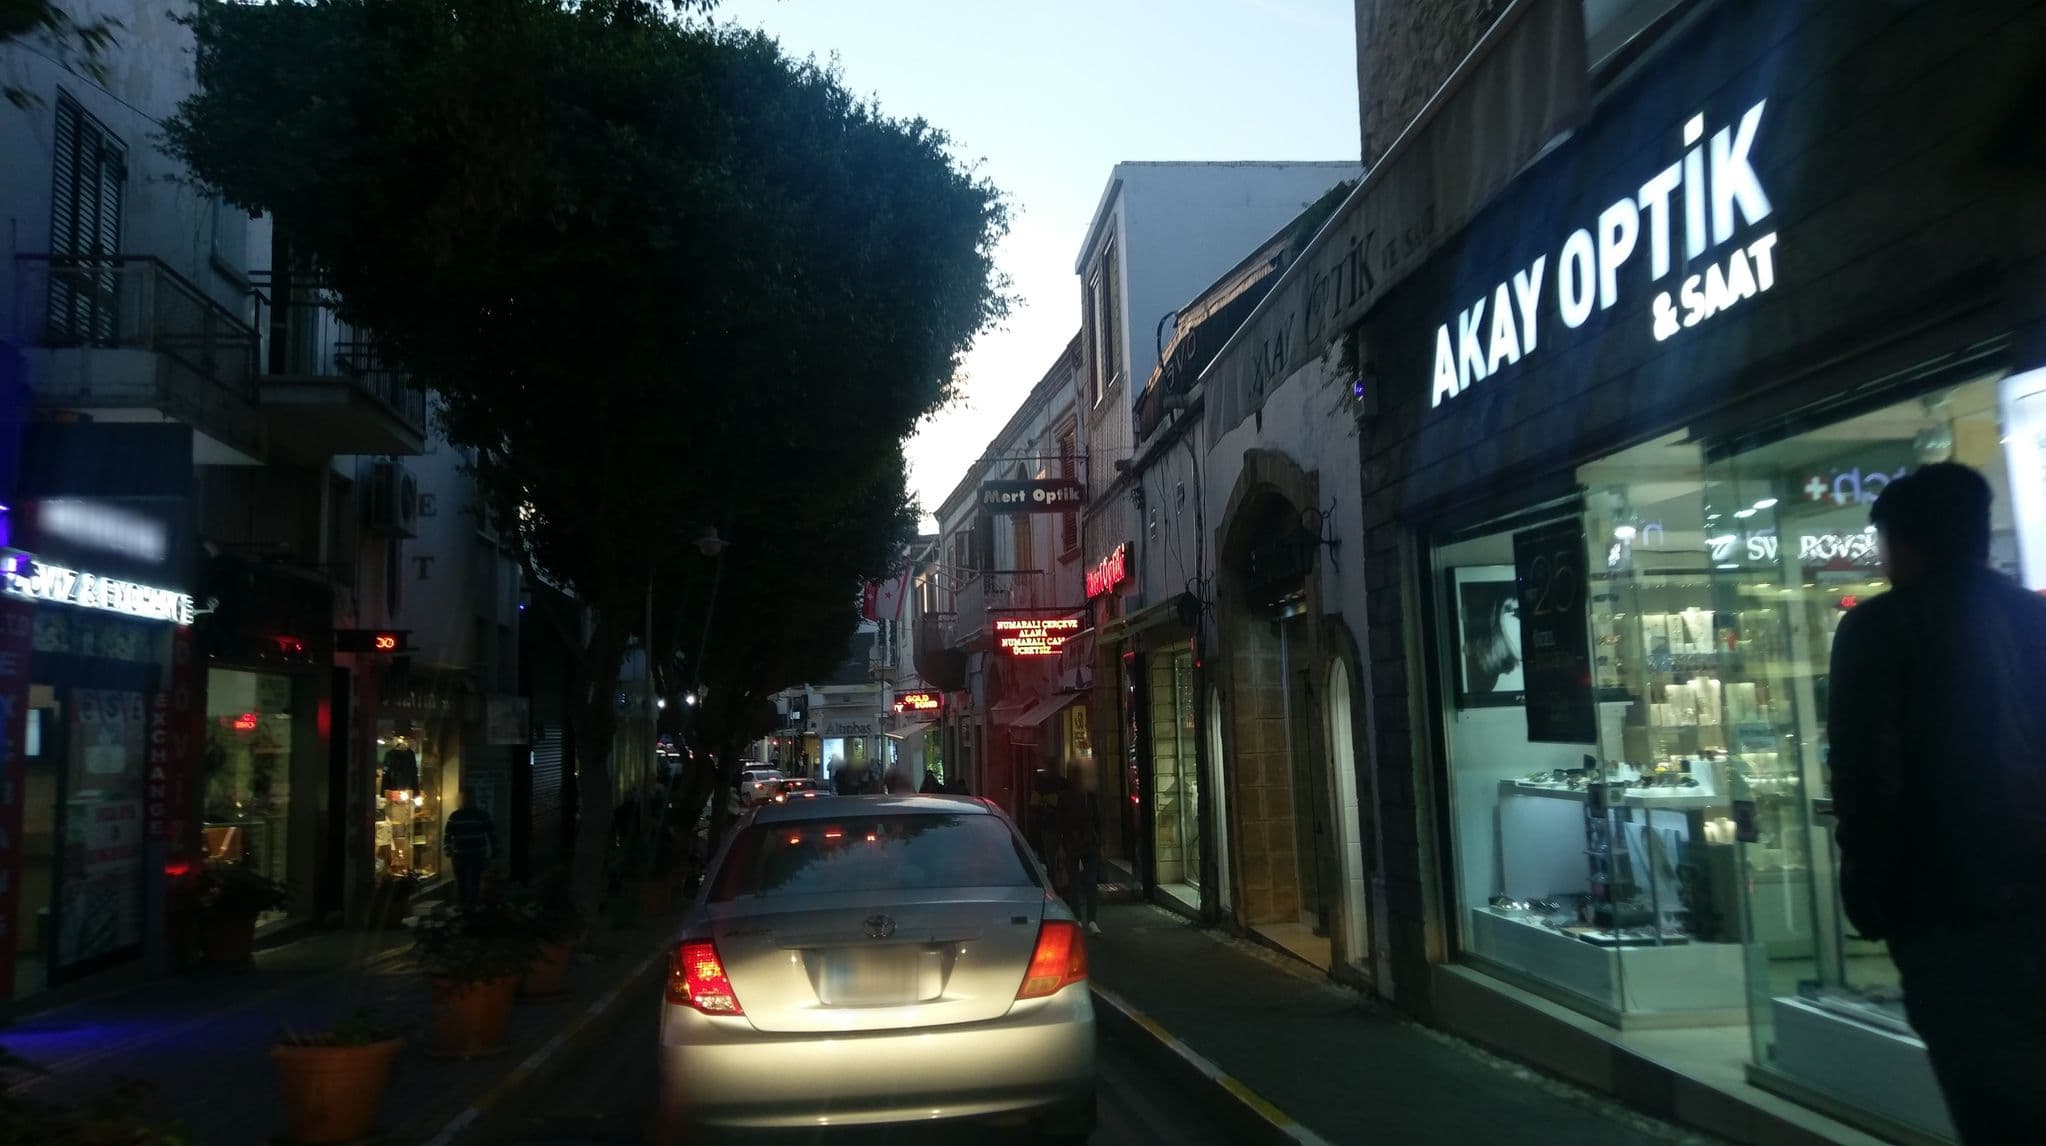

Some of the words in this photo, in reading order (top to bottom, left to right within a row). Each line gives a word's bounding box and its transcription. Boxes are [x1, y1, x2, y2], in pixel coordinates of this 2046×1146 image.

[1432, 253, 1547, 408] AKAY
[1558, 97, 1774, 330] OPTİK
[1652, 291, 1681, 342] &
[1681, 231, 1778, 328] SAAT
[984, 489, 1027, 504] Mert
[1032, 486, 1080, 505] Optik
